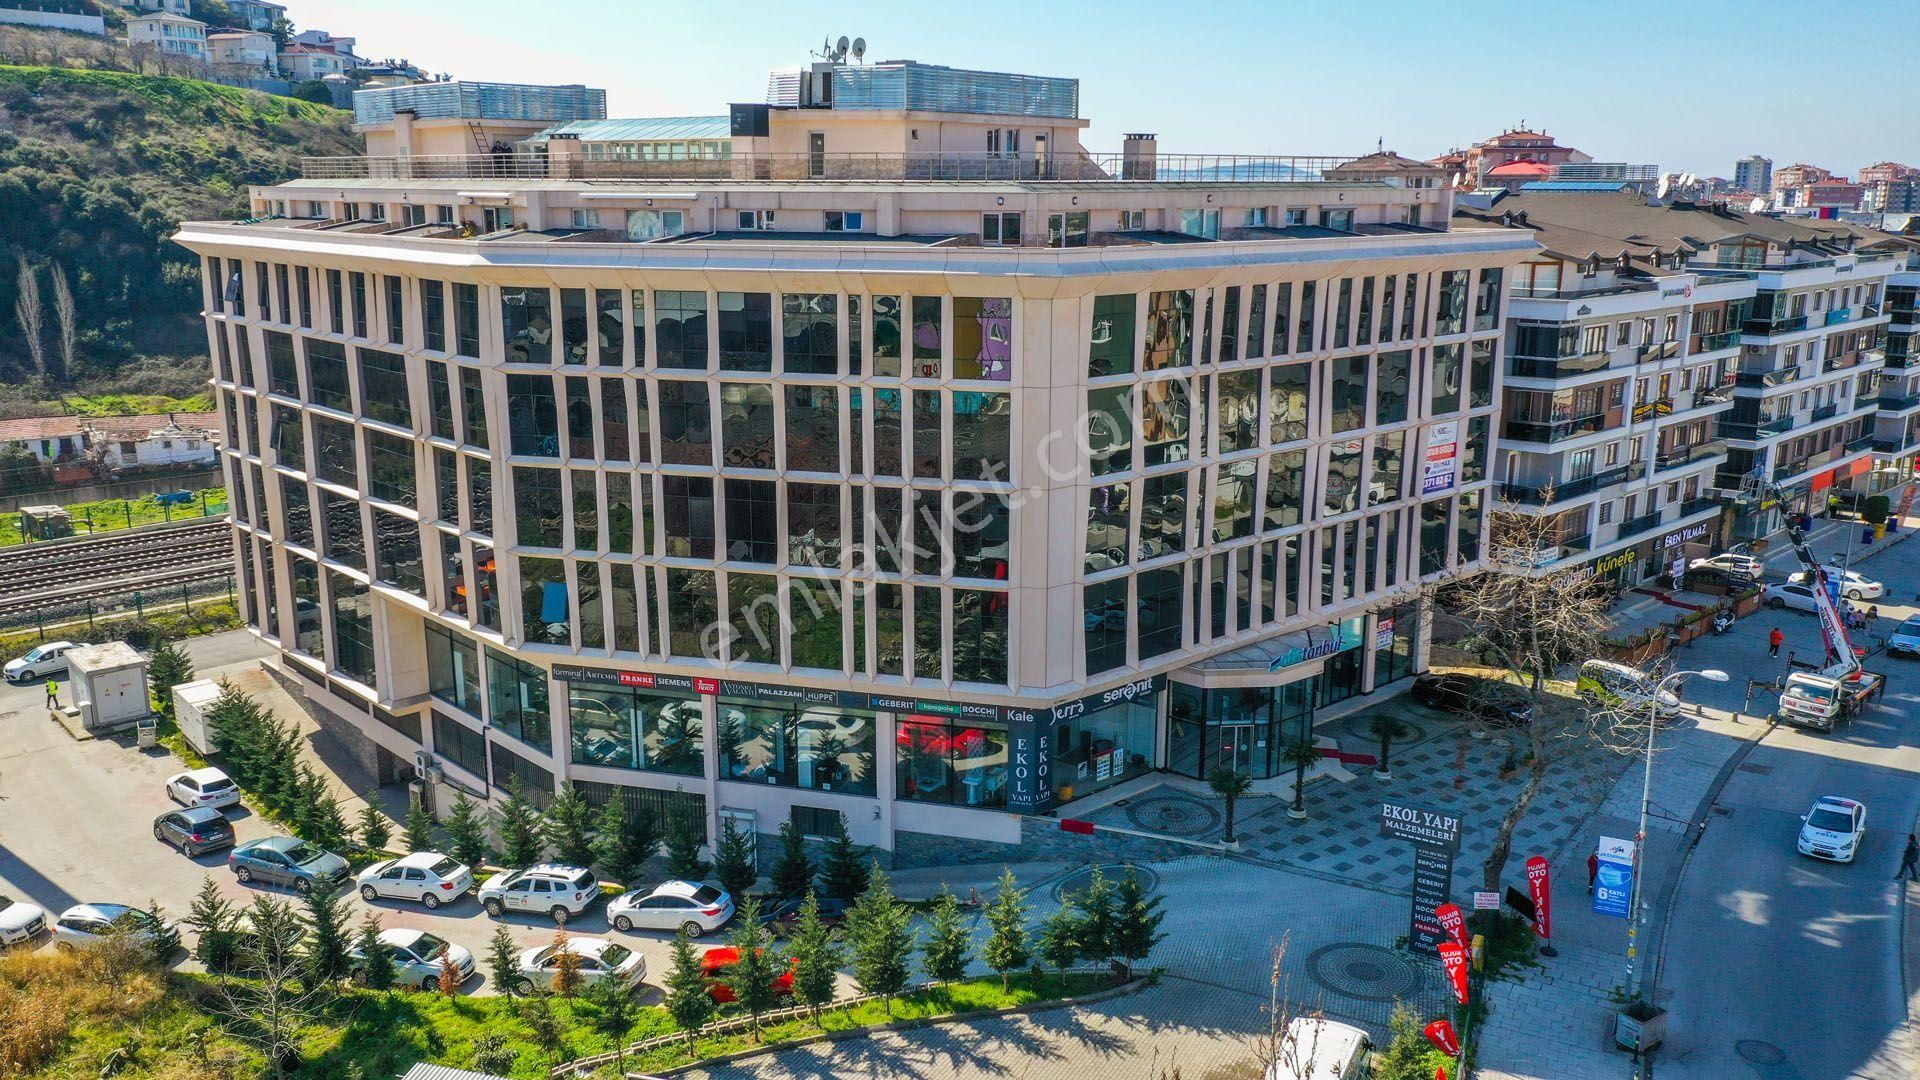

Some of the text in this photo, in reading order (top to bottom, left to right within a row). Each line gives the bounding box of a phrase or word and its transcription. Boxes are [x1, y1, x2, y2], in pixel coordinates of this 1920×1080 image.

[1664, 533, 1681, 547] EREN
[1596, 548, 1635, 574] künefe
[620, 675, 654, 684] FRANKE
[657, 677, 691, 687] SIEMENS
[758, 688, 802, 698] PALAZZANI
[1103, 677, 1153, 703] seranit
[878, 699, 914, 709] GEBERIT
[923, 703, 954, 712] hansgrohe
[962, 705, 995, 715] BOCCHI
[1007, 709, 1034, 722] Kale
[1015, 738, 1028, 793] EKOL
[1038, 736, 1048, 791] EKOL
[1382, 803, 1458, 832] EKOL YAPI
[1385, 819, 1455, 841] MALZEMELERİ
[1417, 877, 1445, 889] GEBERIT
[1598, 887, 1608, 900] 6
[1415, 904, 1436, 915] BOCC
